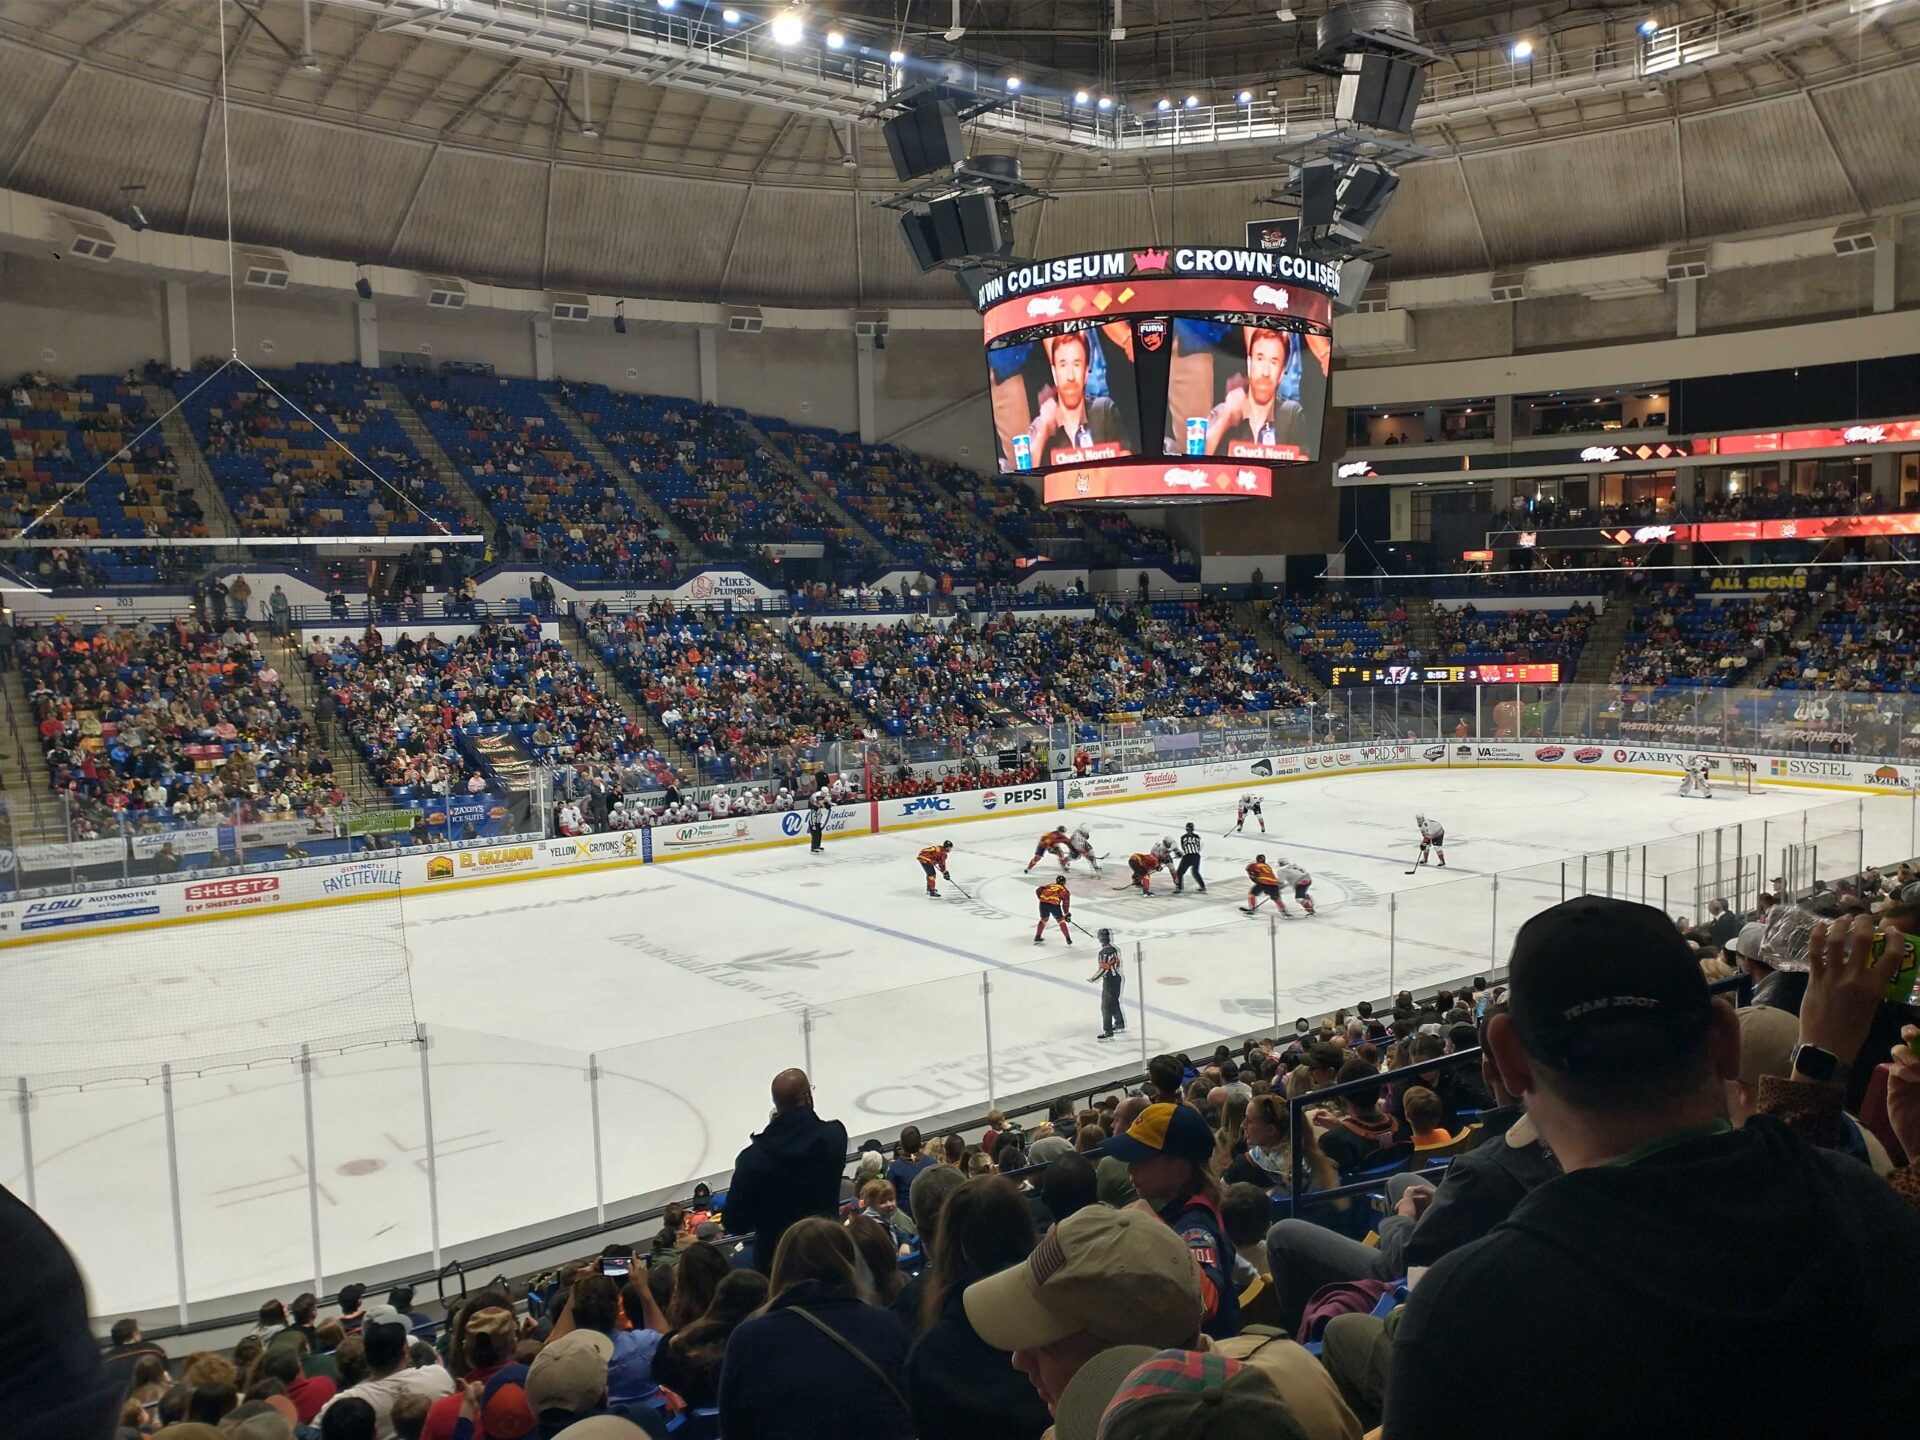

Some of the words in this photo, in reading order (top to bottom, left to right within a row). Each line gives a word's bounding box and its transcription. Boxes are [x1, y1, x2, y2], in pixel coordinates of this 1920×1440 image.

[1175, 249, 1273, 274] CROWN
[1007, 252, 1125, 292] COLISEUM
[1140, 325, 1164, 333] FURY
[1055, 450, 1084, 464] Chuck
[1085, 446, 1116, 461] Norris
[1233, 445, 1264, 459] Chuck
[1265, 447, 1294, 460] Norris
[719, 576, 752, 587] MIKE'S
[1711, 577, 1744, 590] ALL
[1748, 575, 1806, 589] SIGNS
[625, 590, 637, 598] 205
[714, 587, 756, 596] PLUMBING
[1410, 671, 1418, 680] 2
[1469, 671, 1477, 679] 3
[1277, 756, 1299, 764] ABBOTT
[1360, 746, 1390, 761] WORLD
[1478, 748, 1491, 757] VA
[1629, 751, 1684, 767] ZAXBY'S
[1790, 760, 1851, 776] SYSTEL
[1143, 771, 1178, 788] Freddy's
[1864, 774, 1910, 787] FAZOLI'S
[1004, 788, 1047, 804] PEPSI
[454, 804, 484, 816] ZAXBY'S
[903, 796, 950, 816] PWC
[452, 815, 463, 823] ICE
[464, 813, 485, 822] SUITE
[185, 830, 209, 838] AUTO
[699, 822, 729, 832] Minuteman
[550, 845, 577, 857] YELLOW
[589, 840, 619, 853] CRAYONS
[459, 852, 476, 868] EL
[478, 847, 533, 866] CAZADOR
[341, 863, 385, 873] DISTINCTLY
[189, 878, 275, 899] SHEETZ
[322, 870, 402, 894] FAYETTEVILLE
[26, 898, 84, 914] FLOW
[88, 890, 157, 903] AUTOMOTIVE
[205, 896, 261, 909] SHEETZ.COM
[1563, 998, 1609, 1020] TEAM
